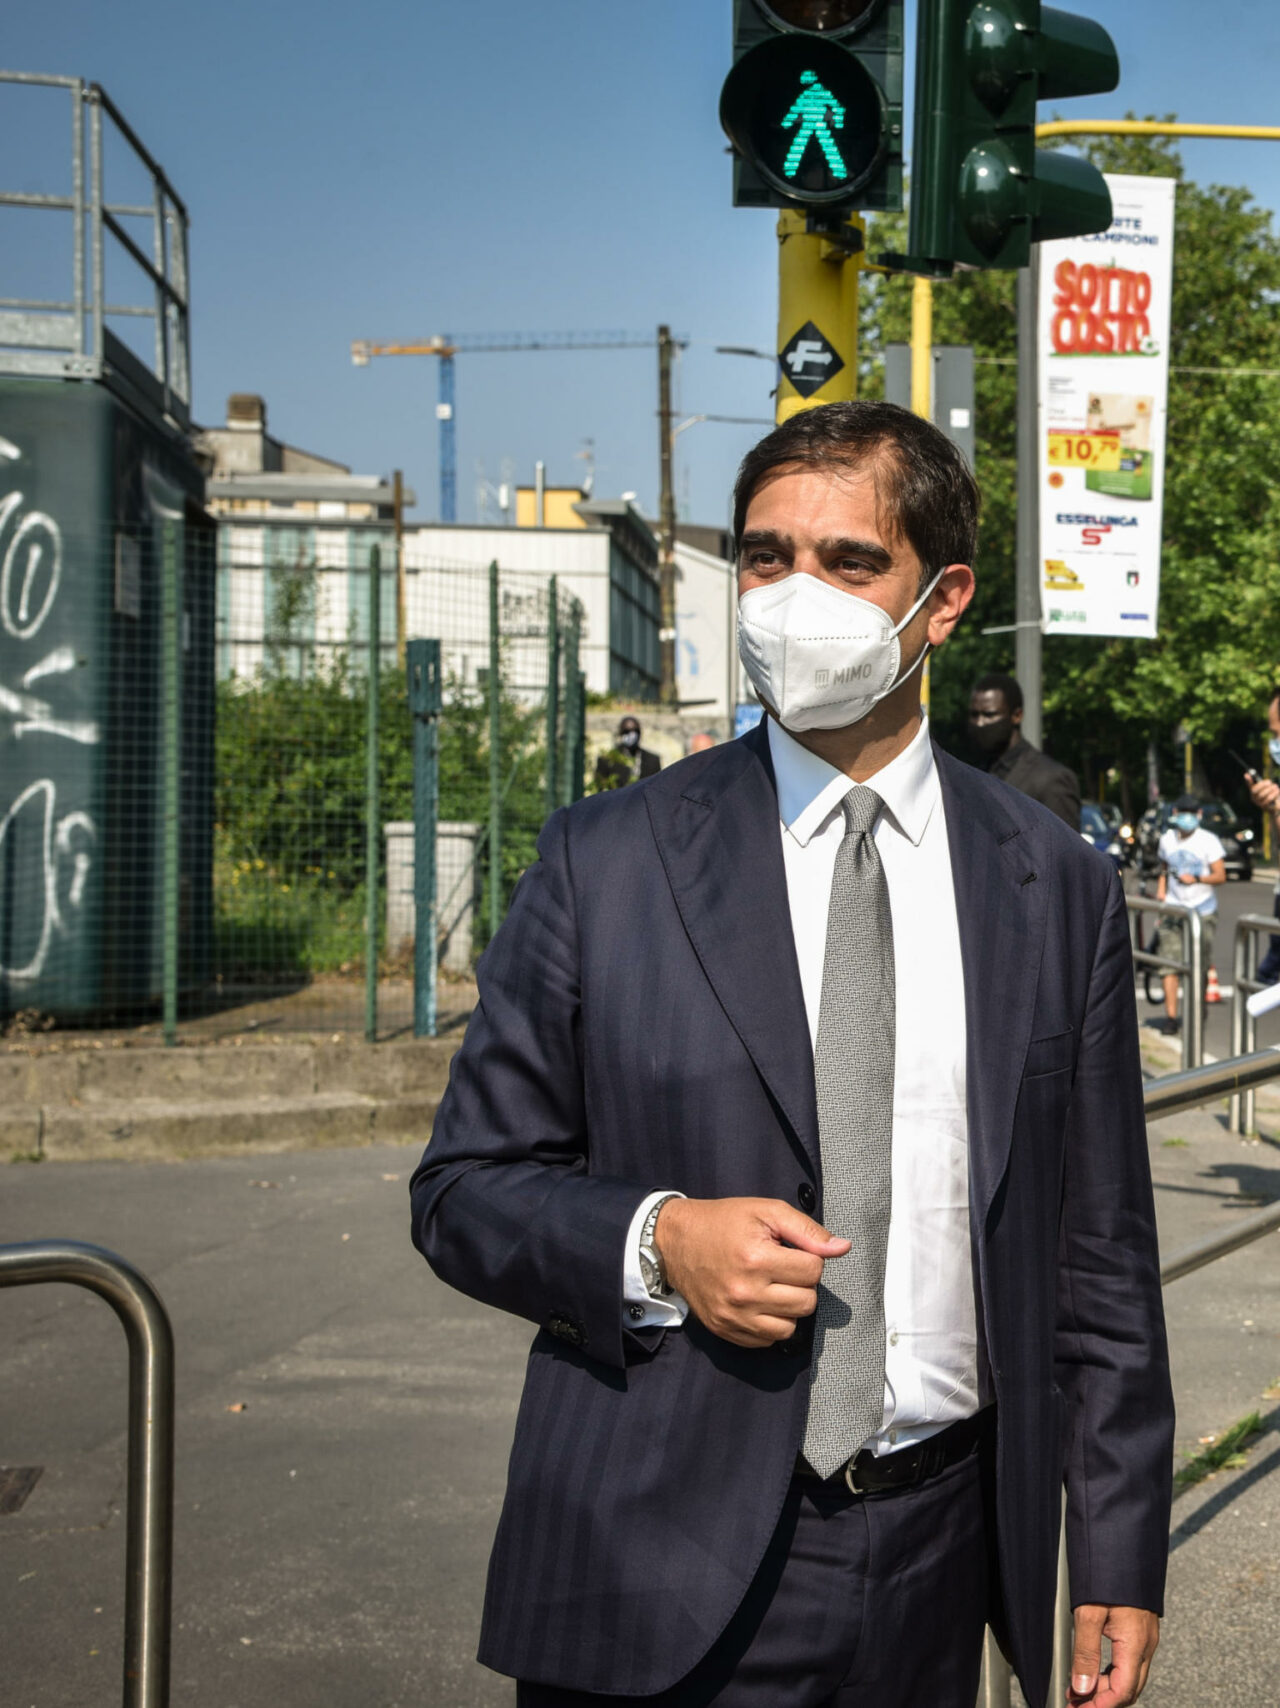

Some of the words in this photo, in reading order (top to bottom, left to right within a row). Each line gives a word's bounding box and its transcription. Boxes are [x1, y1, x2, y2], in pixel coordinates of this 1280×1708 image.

[1054, 259, 1151, 309] SOTTO
[1056, 513, 1138, 527] ESSELUNGA
[833, 663, 872, 686] MIMO
